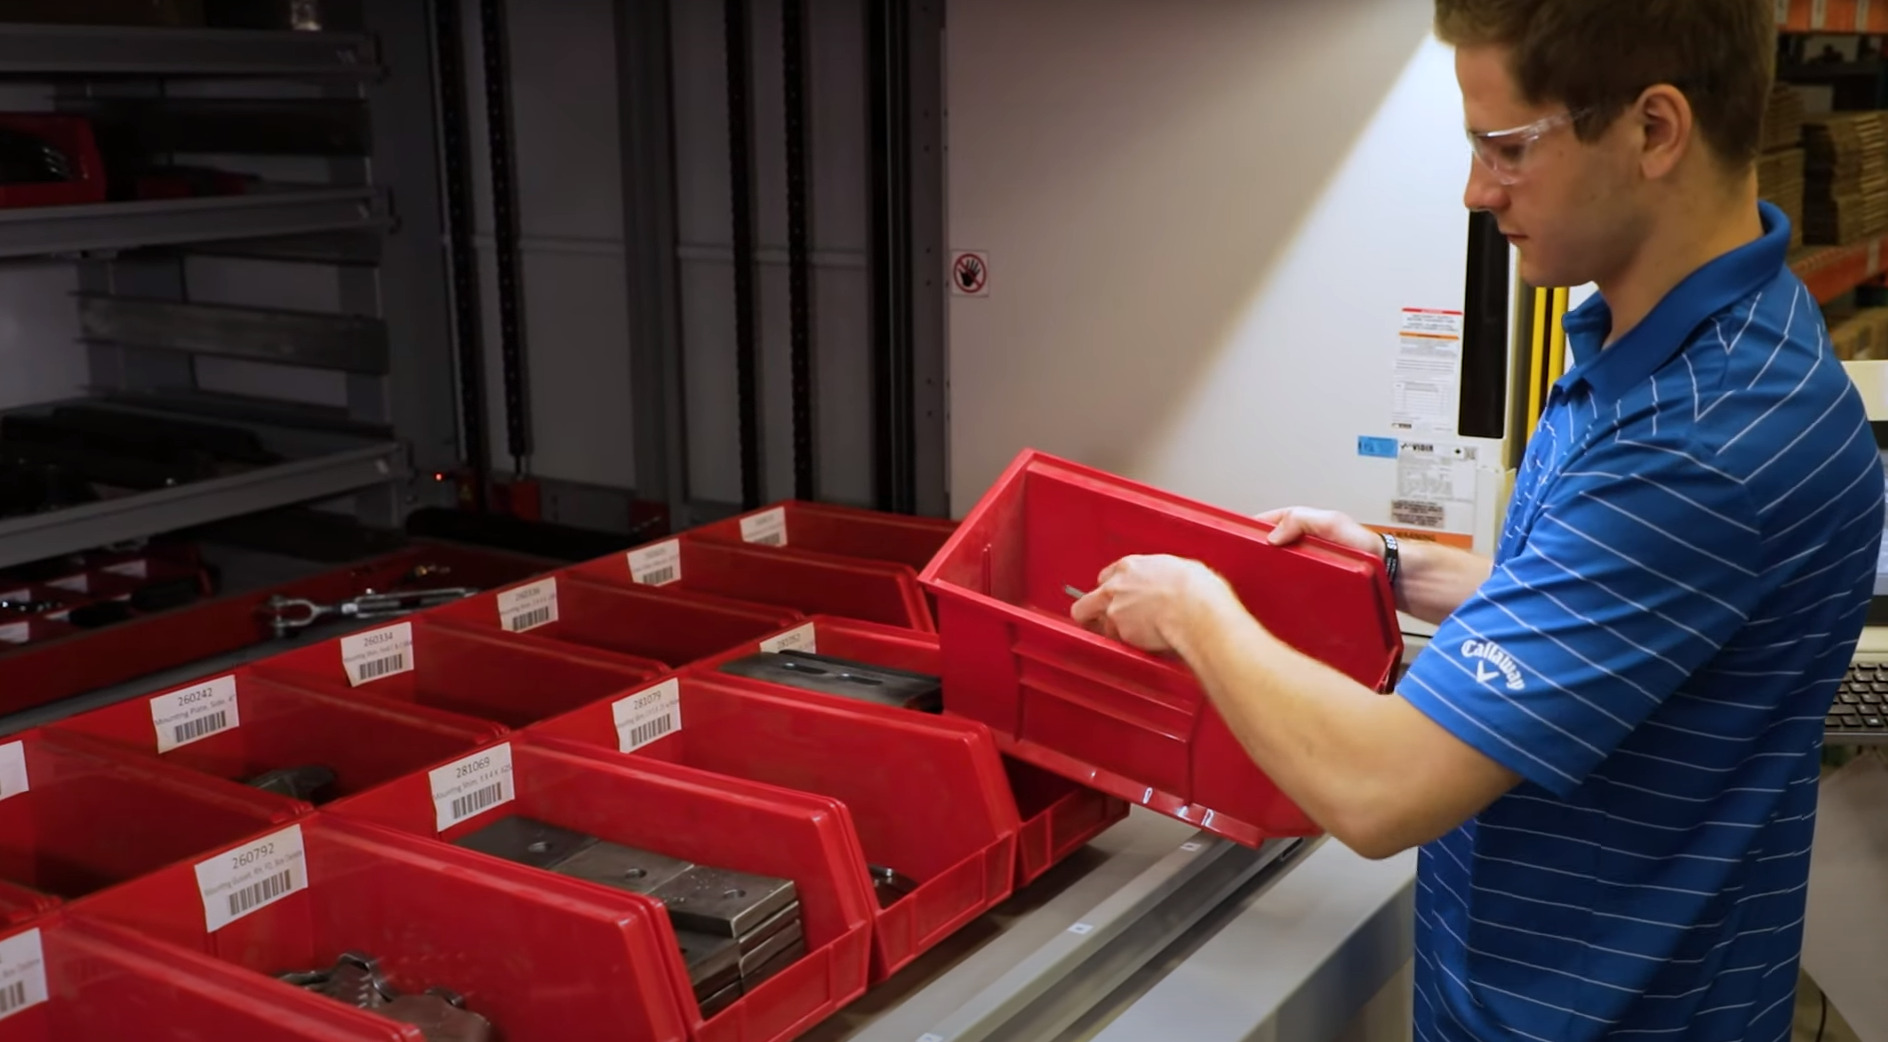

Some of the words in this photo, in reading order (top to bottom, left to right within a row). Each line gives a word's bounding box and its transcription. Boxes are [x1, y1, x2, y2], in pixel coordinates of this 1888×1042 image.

[1461, 639, 1525, 690] Callaway
[178, 687, 213, 707] 260242
[456, 757, 491, 779] 281069
[232, 842, 275, 870] 260792
